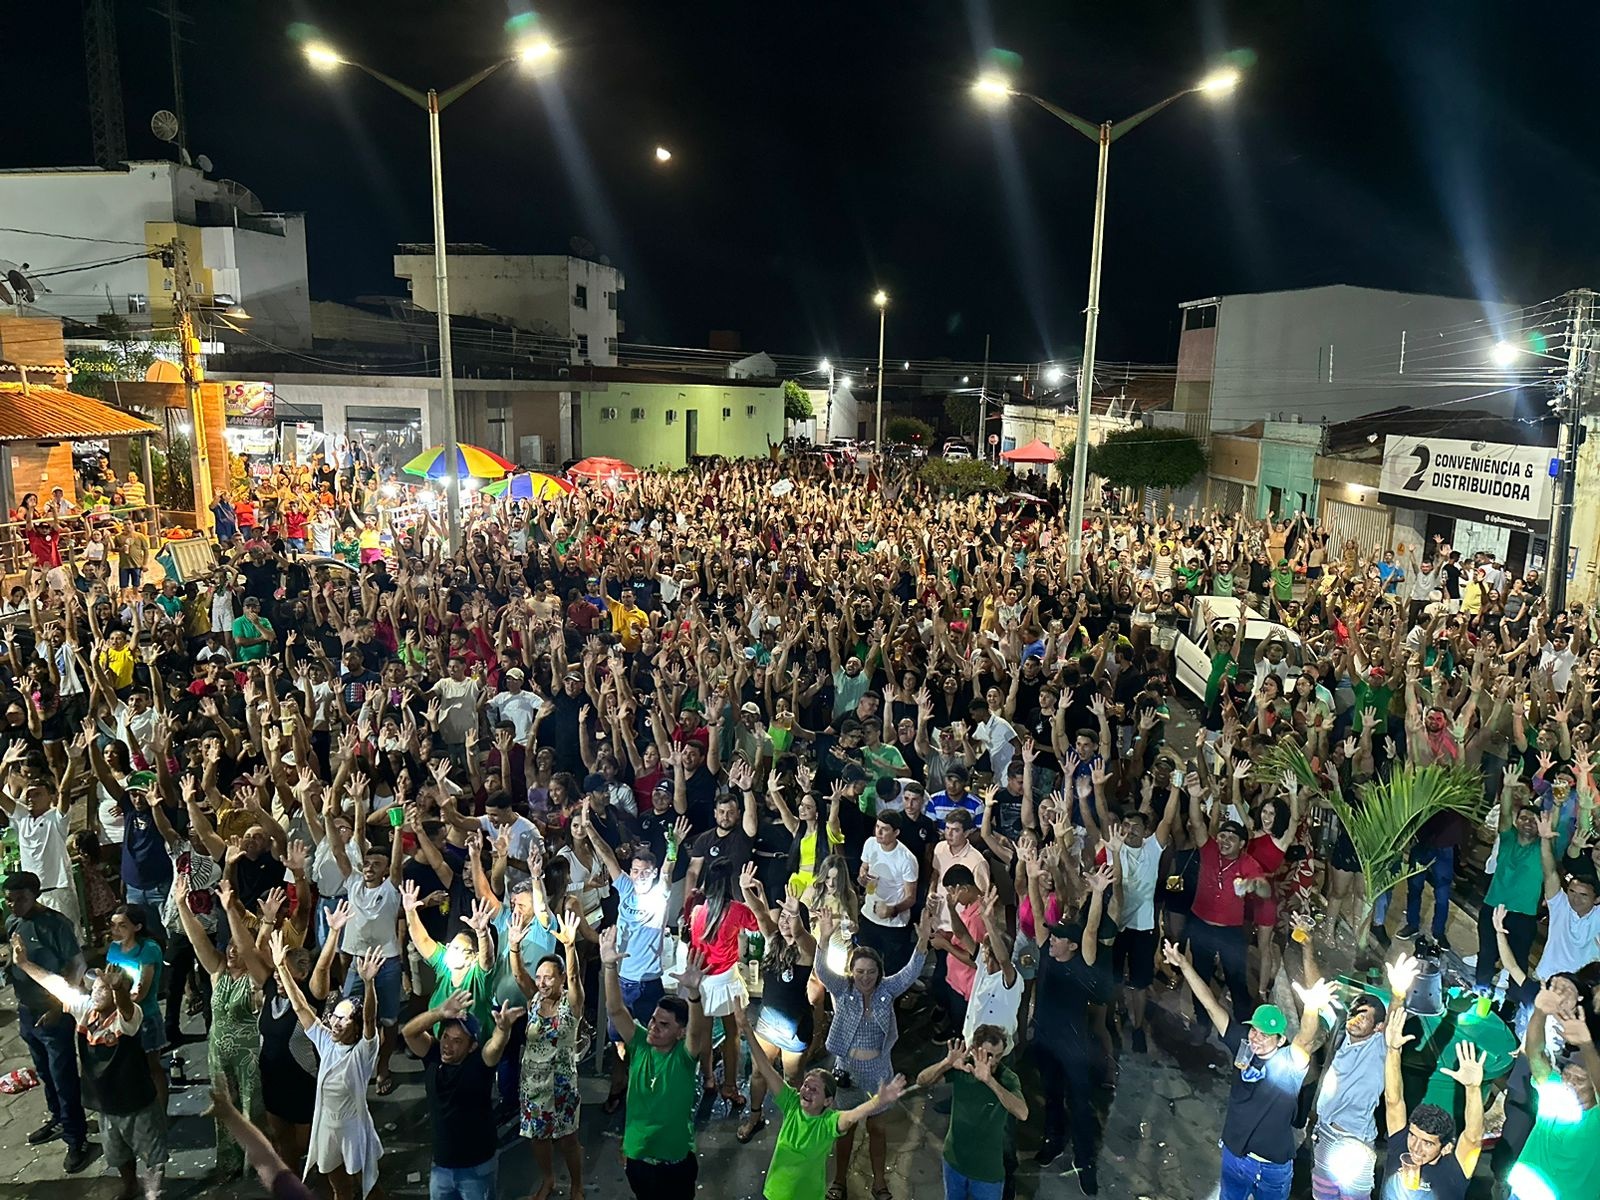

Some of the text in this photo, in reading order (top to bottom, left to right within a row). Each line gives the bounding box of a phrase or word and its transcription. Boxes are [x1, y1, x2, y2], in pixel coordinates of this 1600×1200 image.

[1434, 453, 1534, 479] CONVENIÊNCIA &
[1431, 471, 1530, 502] DISTRIBUIDORA
